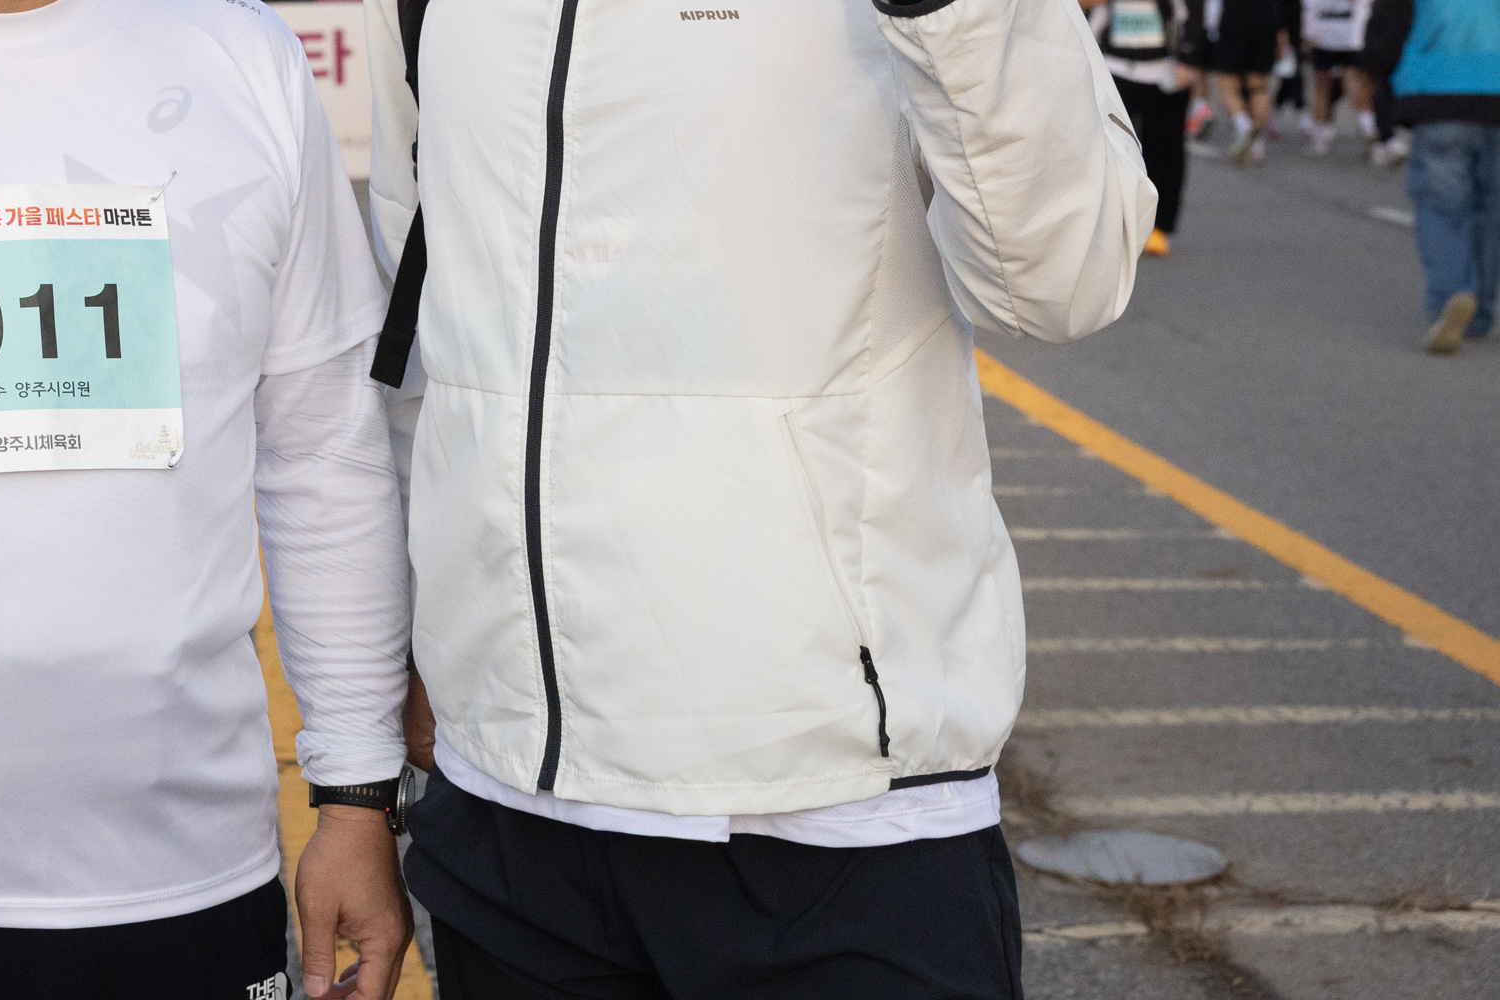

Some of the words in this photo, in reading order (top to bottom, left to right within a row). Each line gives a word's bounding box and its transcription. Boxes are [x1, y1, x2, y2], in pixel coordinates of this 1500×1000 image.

[679, 10, 740, 21] KIPRUN
[4, 206, 43, 227] 가을
[45, 207, 102, 227] 페스타
[103, 208, 153, 227] 마라톤
[15, 381, 91, 398] 양주시의원
[246, 975, 275, 1000] THE
